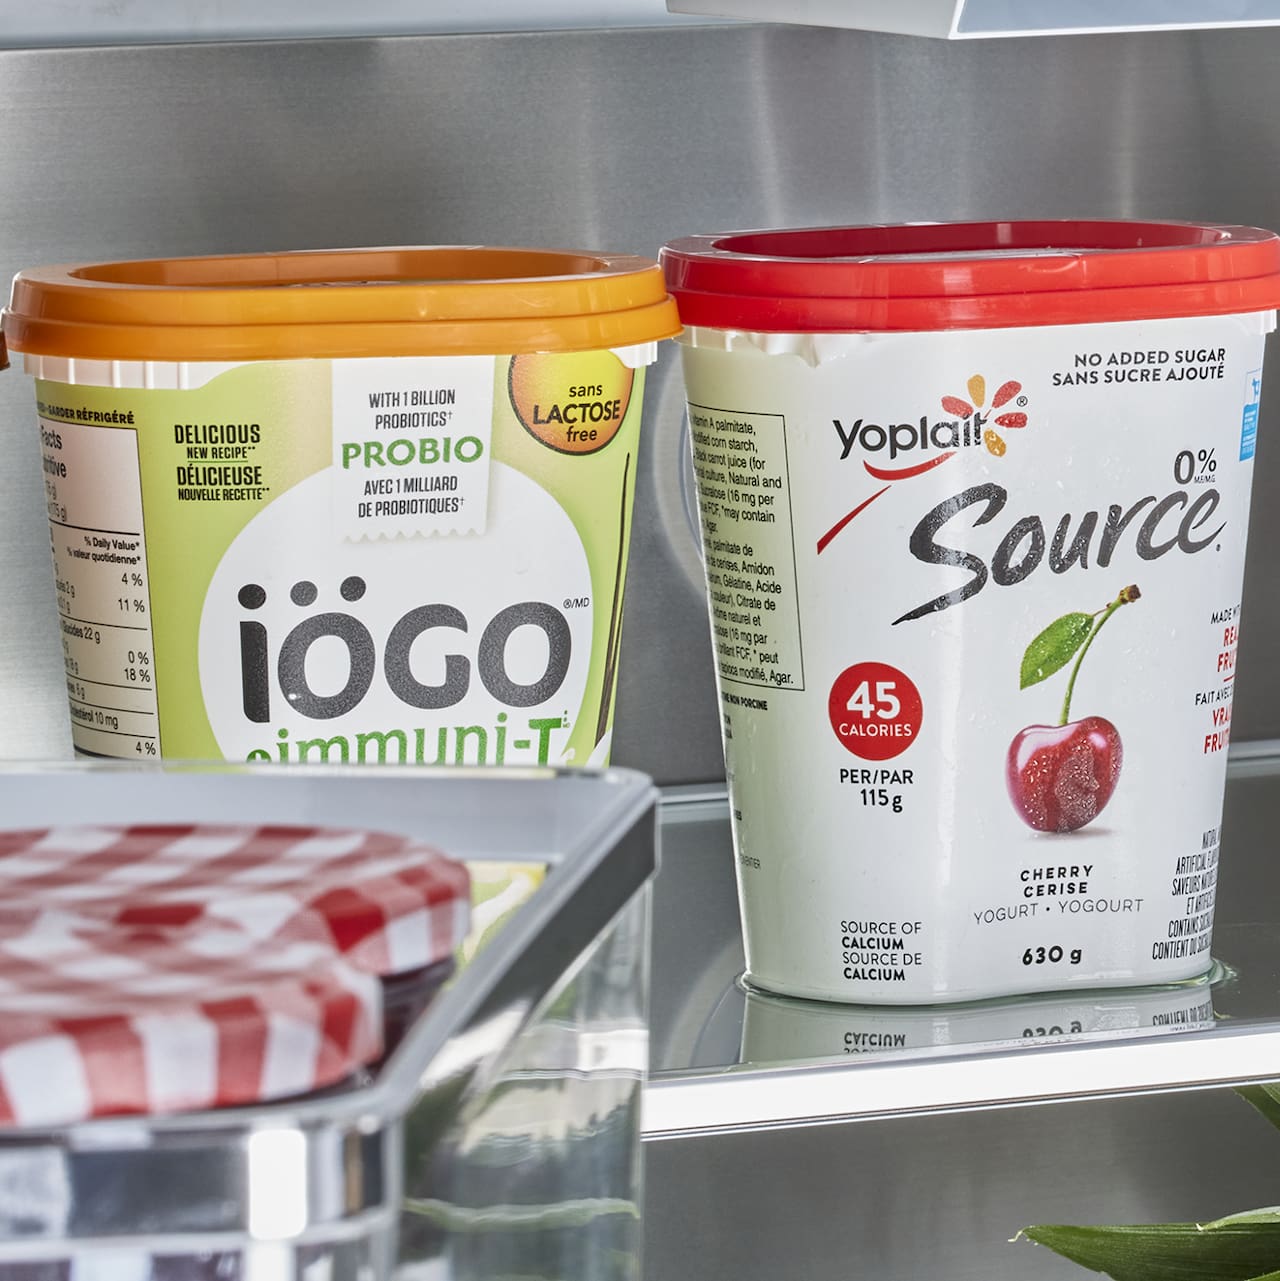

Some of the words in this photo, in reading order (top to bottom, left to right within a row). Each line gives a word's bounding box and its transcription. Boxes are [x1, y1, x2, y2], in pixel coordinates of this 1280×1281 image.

[1074, 353, 1102, 368] NO
[1106, 351, 1170, 367] ADDED
[1174, 347, 1226, 364] SUGAR
[1052, 370, 1098, 386] SANS
[1103, 367, 1161, 384] SUCRE
[1165, 362, 1224, 382] AJOUTÉ
[369, 392, 400, 409] WITH
[411, 389, 456, 406] BILLION
[569, 384, 603, 398] sans
[76, 407, 135, 424] RÉFRIGÉRÉ
[533, 399, 621, 425] LACTOSE
[174, 424, 260, 444] DELICIOUS
[566, 425, 598, 442] free
[716, 419, 756, 436] palmitate,
[187, 446, 208, 459] NEW
[341, 435, 484, 470] PROBIO
[728, 438, 758, 453] starch,
[727, 453, 747, 469] juice
[749, 455, 766, 472] (for
[1173, 447, 1217, 485] 0%
[176, 463, 263, 486] DÉLICIEUSE
[728, 471, 760, 487] Natural
[762, 476, 782, 489] and
[178, 487, 220, 501] NOUVELLE
[364, 478, 393, 496] AVEC
[403, 475, 458, 493] MILLIARD
[741, 493, 756, 507] mg
[758, 494, 774, 507] per
[358, 502, 372, 518] DE
[741, 509, 775, 523] contain
[93, 537, 111, 550] Daily
[742, 542, 753, 556] de
[891, 482, 1228, 626] Source
[741, 560, 775, 576] Amidon
[722, 573, 754, 592] Gélatine,
[756, 578, 782, 594] Acide
[736, 593, 762, 609] Citrate
[764, 598, 776, 611] de
[752, 615, 762, 627] et
[1211, 608, 1232, 624] MADE
[740, 631, 752, 645] mg
[753, 632, 768, 646] par
[759, 651, 778, 665] peut
[769, 669, 794, 686] Agar.
[741, 695, 768, 711] PORCINE
[846, 680, 901, 720] 45
[1195, 691, 1215, 706] FAIT
[838, 723, 913, 737] CALORIES
[839, 768, 914, 785] PER/PAR
[860, 788, 889, 806] 115
[892, 795, 903, 813] g
[1020, 864, 1093, 882] CHERRY
[1023, 882, 1088, 898] CERISE
[974, 903, 1039, 925] YOGURT
[1058, 898, 1144, 914] YOGOURT
[840, 920, 897, 935] SOURCE
[901, 921, 922, 935] OF
[841, 936, 904, 951] CALCIUM
[1152, 938, 1189, 960] CONTIENT
[843, 951, 898, 966] SOURCE
[903, 952, 922, 966] DE
[1022, 945, 1063, 966] 630
[1070, 947, 1083, 965] g
[843, 968, 905, 981] CALCIUM
